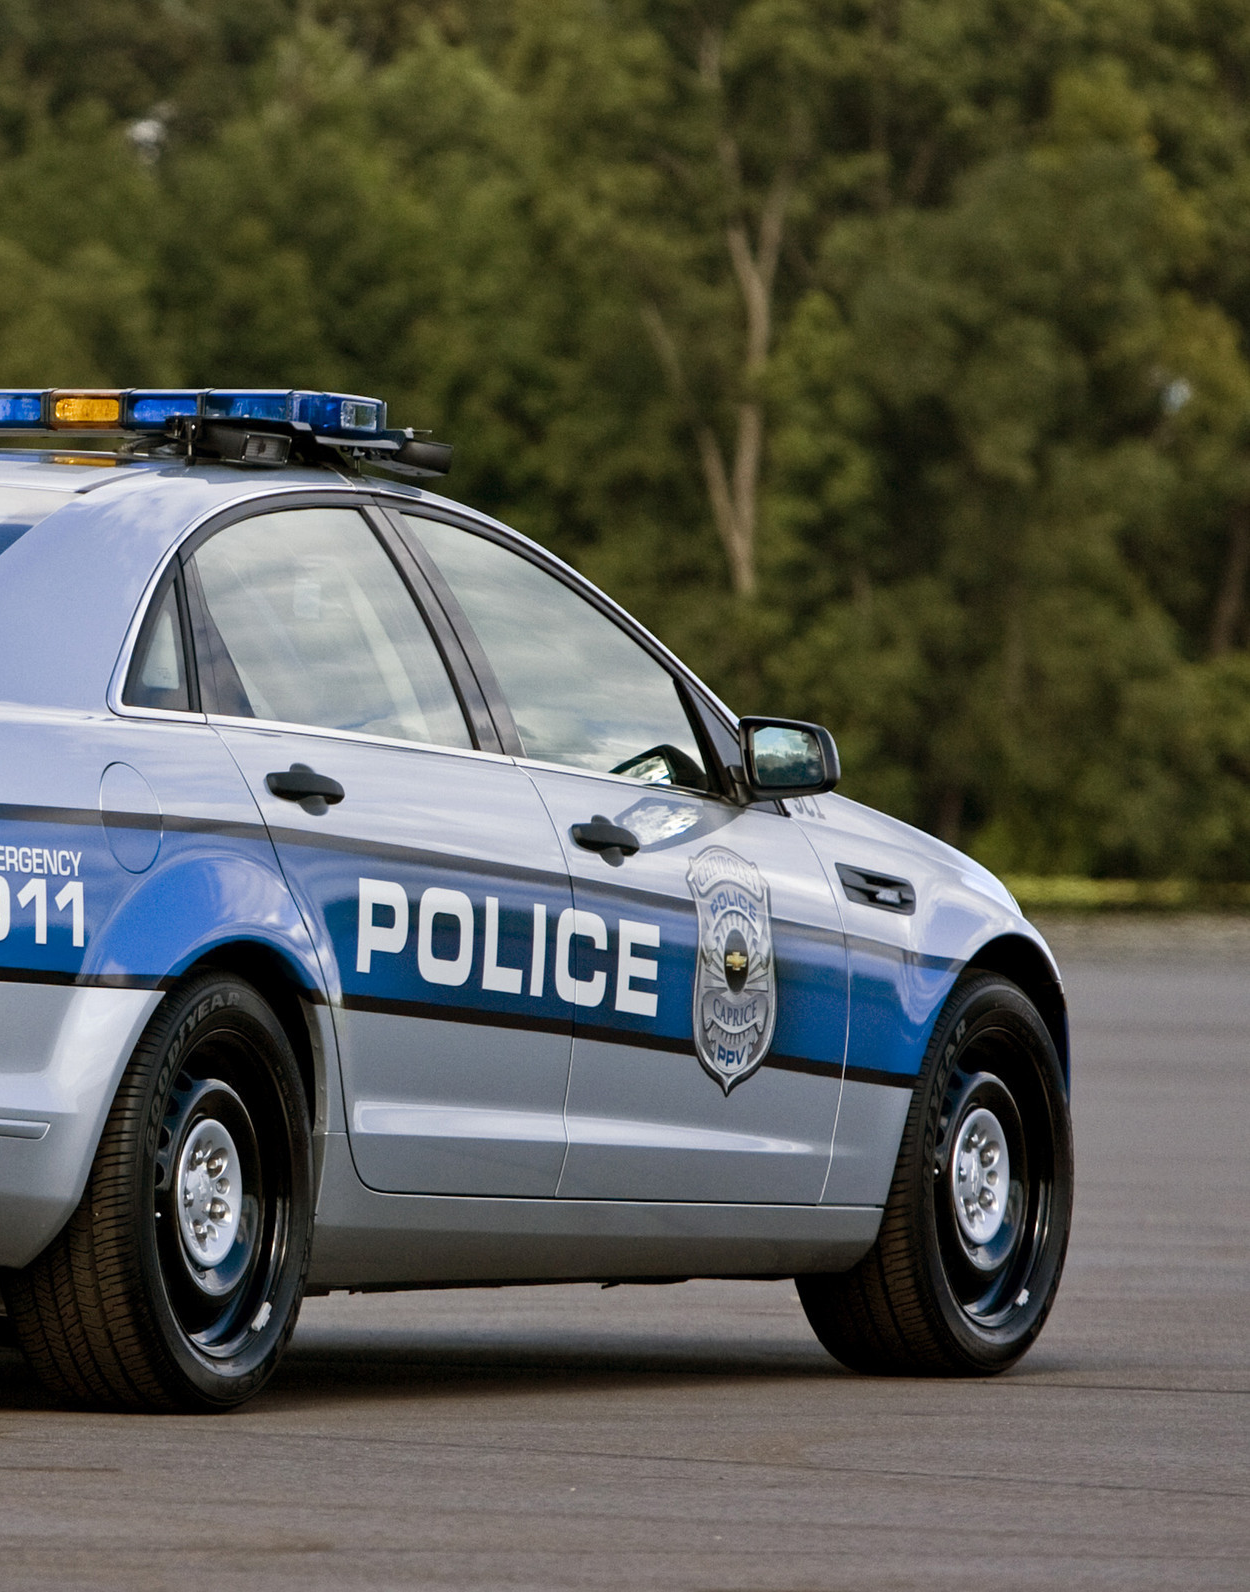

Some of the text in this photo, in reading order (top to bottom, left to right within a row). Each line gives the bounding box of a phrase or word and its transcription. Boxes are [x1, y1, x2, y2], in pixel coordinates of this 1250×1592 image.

[710, 889, 758, 924] POLICE
[356, 877, 661, 1018] POLICE
[713, 998, 758, 1027] CAPRICE
[716, 1044, 747, 1067] PPV
[146, 992, 240, 1156] GOODYEAR
